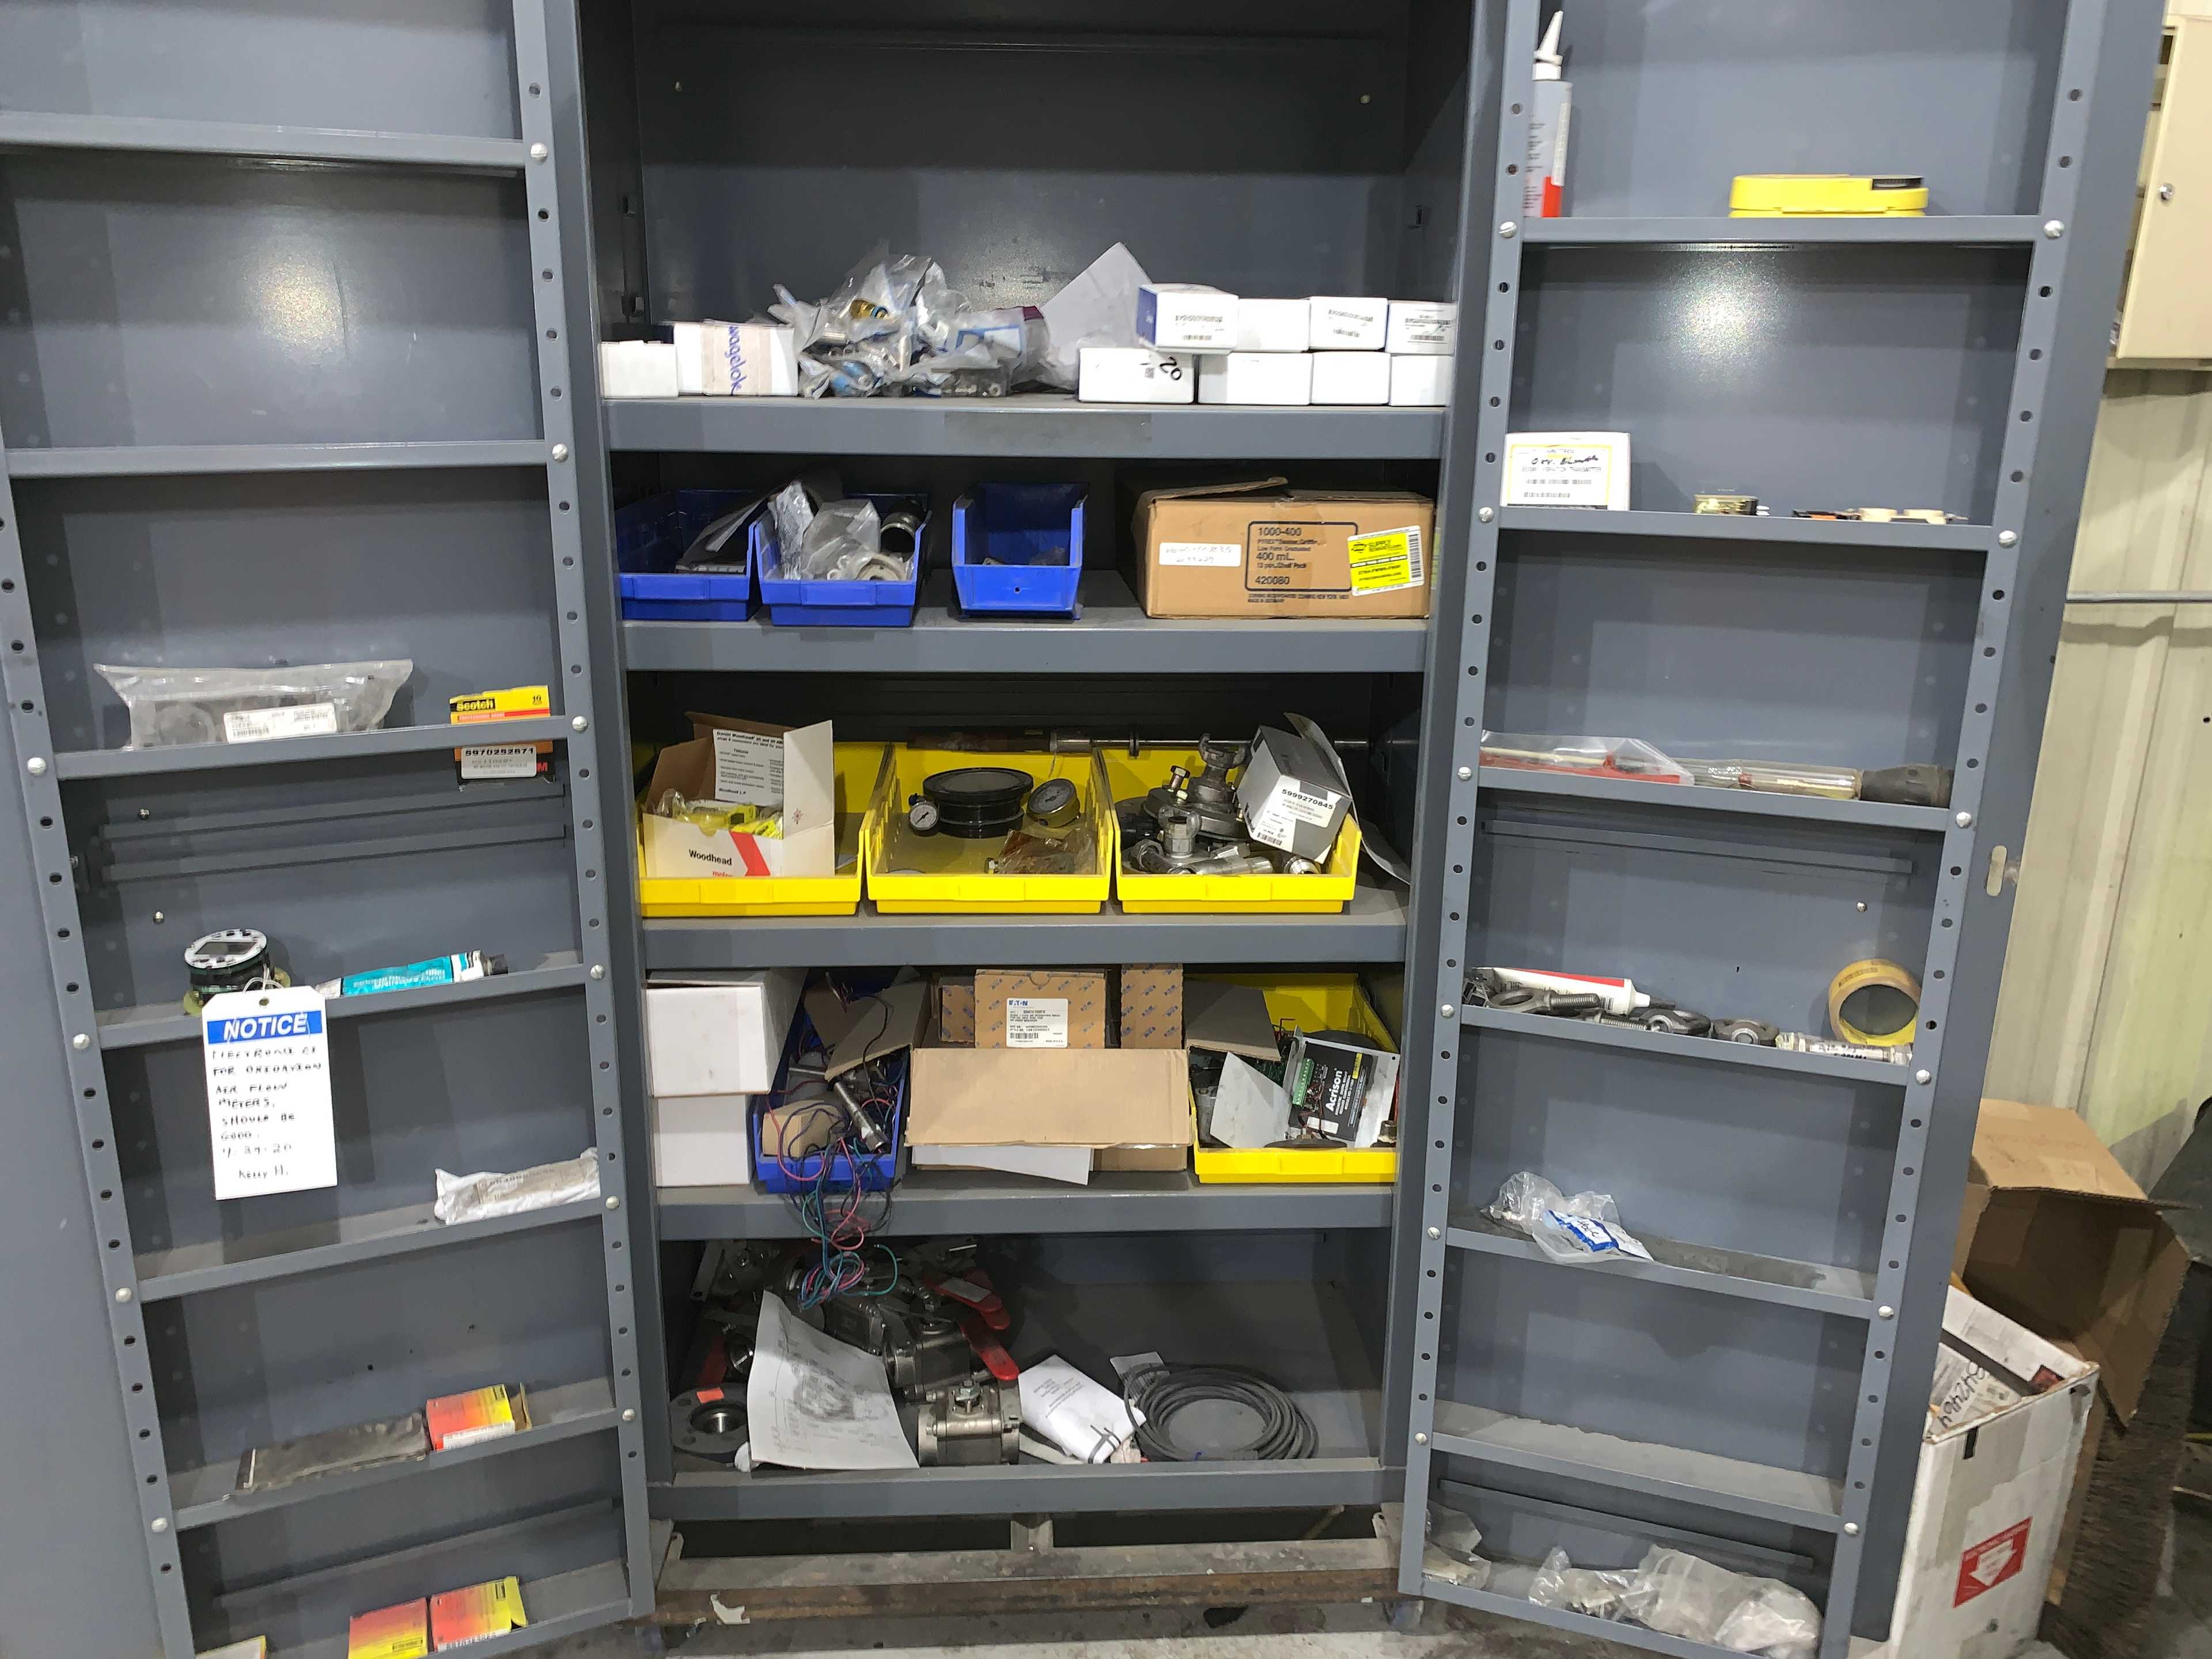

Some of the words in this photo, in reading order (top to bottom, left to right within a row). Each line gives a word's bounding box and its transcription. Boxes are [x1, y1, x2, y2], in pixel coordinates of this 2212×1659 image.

[725, 326, 747, 396] wagelok
[1258, 527, 1302, 536] 1000-400
[1256, 552, 1274, 560] 400
[456, 698, 494, 711] Scotch
[1281, 789, 1334, 810] 5999270845
[688, 849, 732, 866] Woodhead
[224, 1013, 308, 1041] NOTICE
[1325, 1070, 1343, 1112] Acrison
